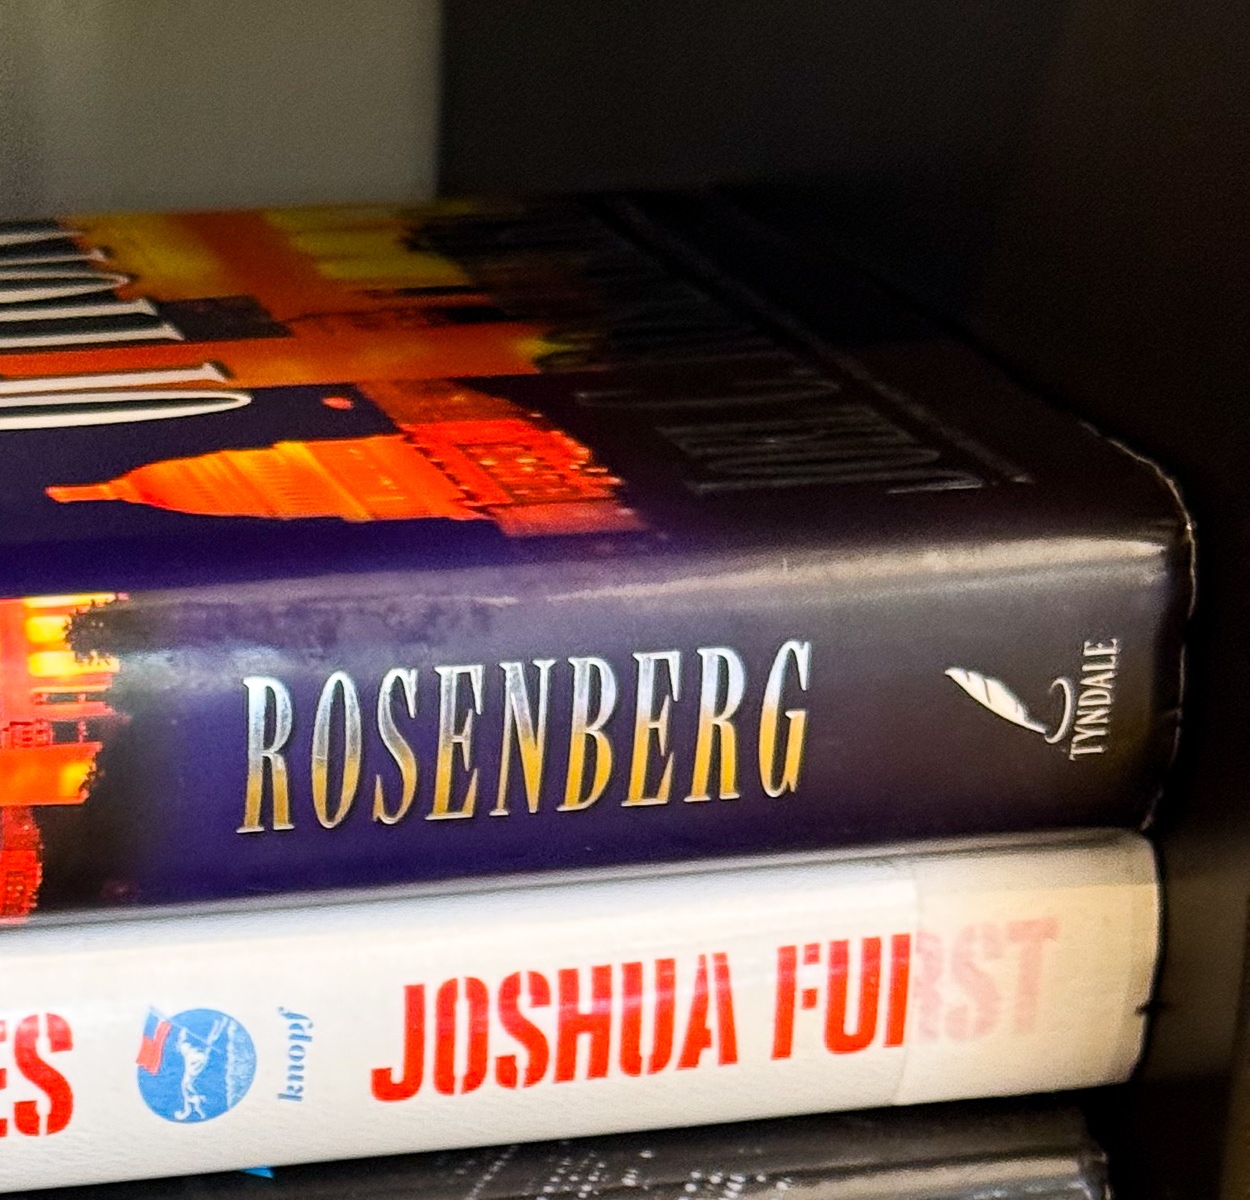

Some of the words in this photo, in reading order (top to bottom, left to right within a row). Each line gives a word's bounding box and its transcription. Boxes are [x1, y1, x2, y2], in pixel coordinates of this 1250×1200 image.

[236, 640, 811, 834] ROSENBERG
[1068, 638, 1119, 761] TYNDALE
[275, 1006, 314, 1102] knopf
[370, 951, 740, 1102] JOSHUA
[771, 916, 1060, 1061] FURST
